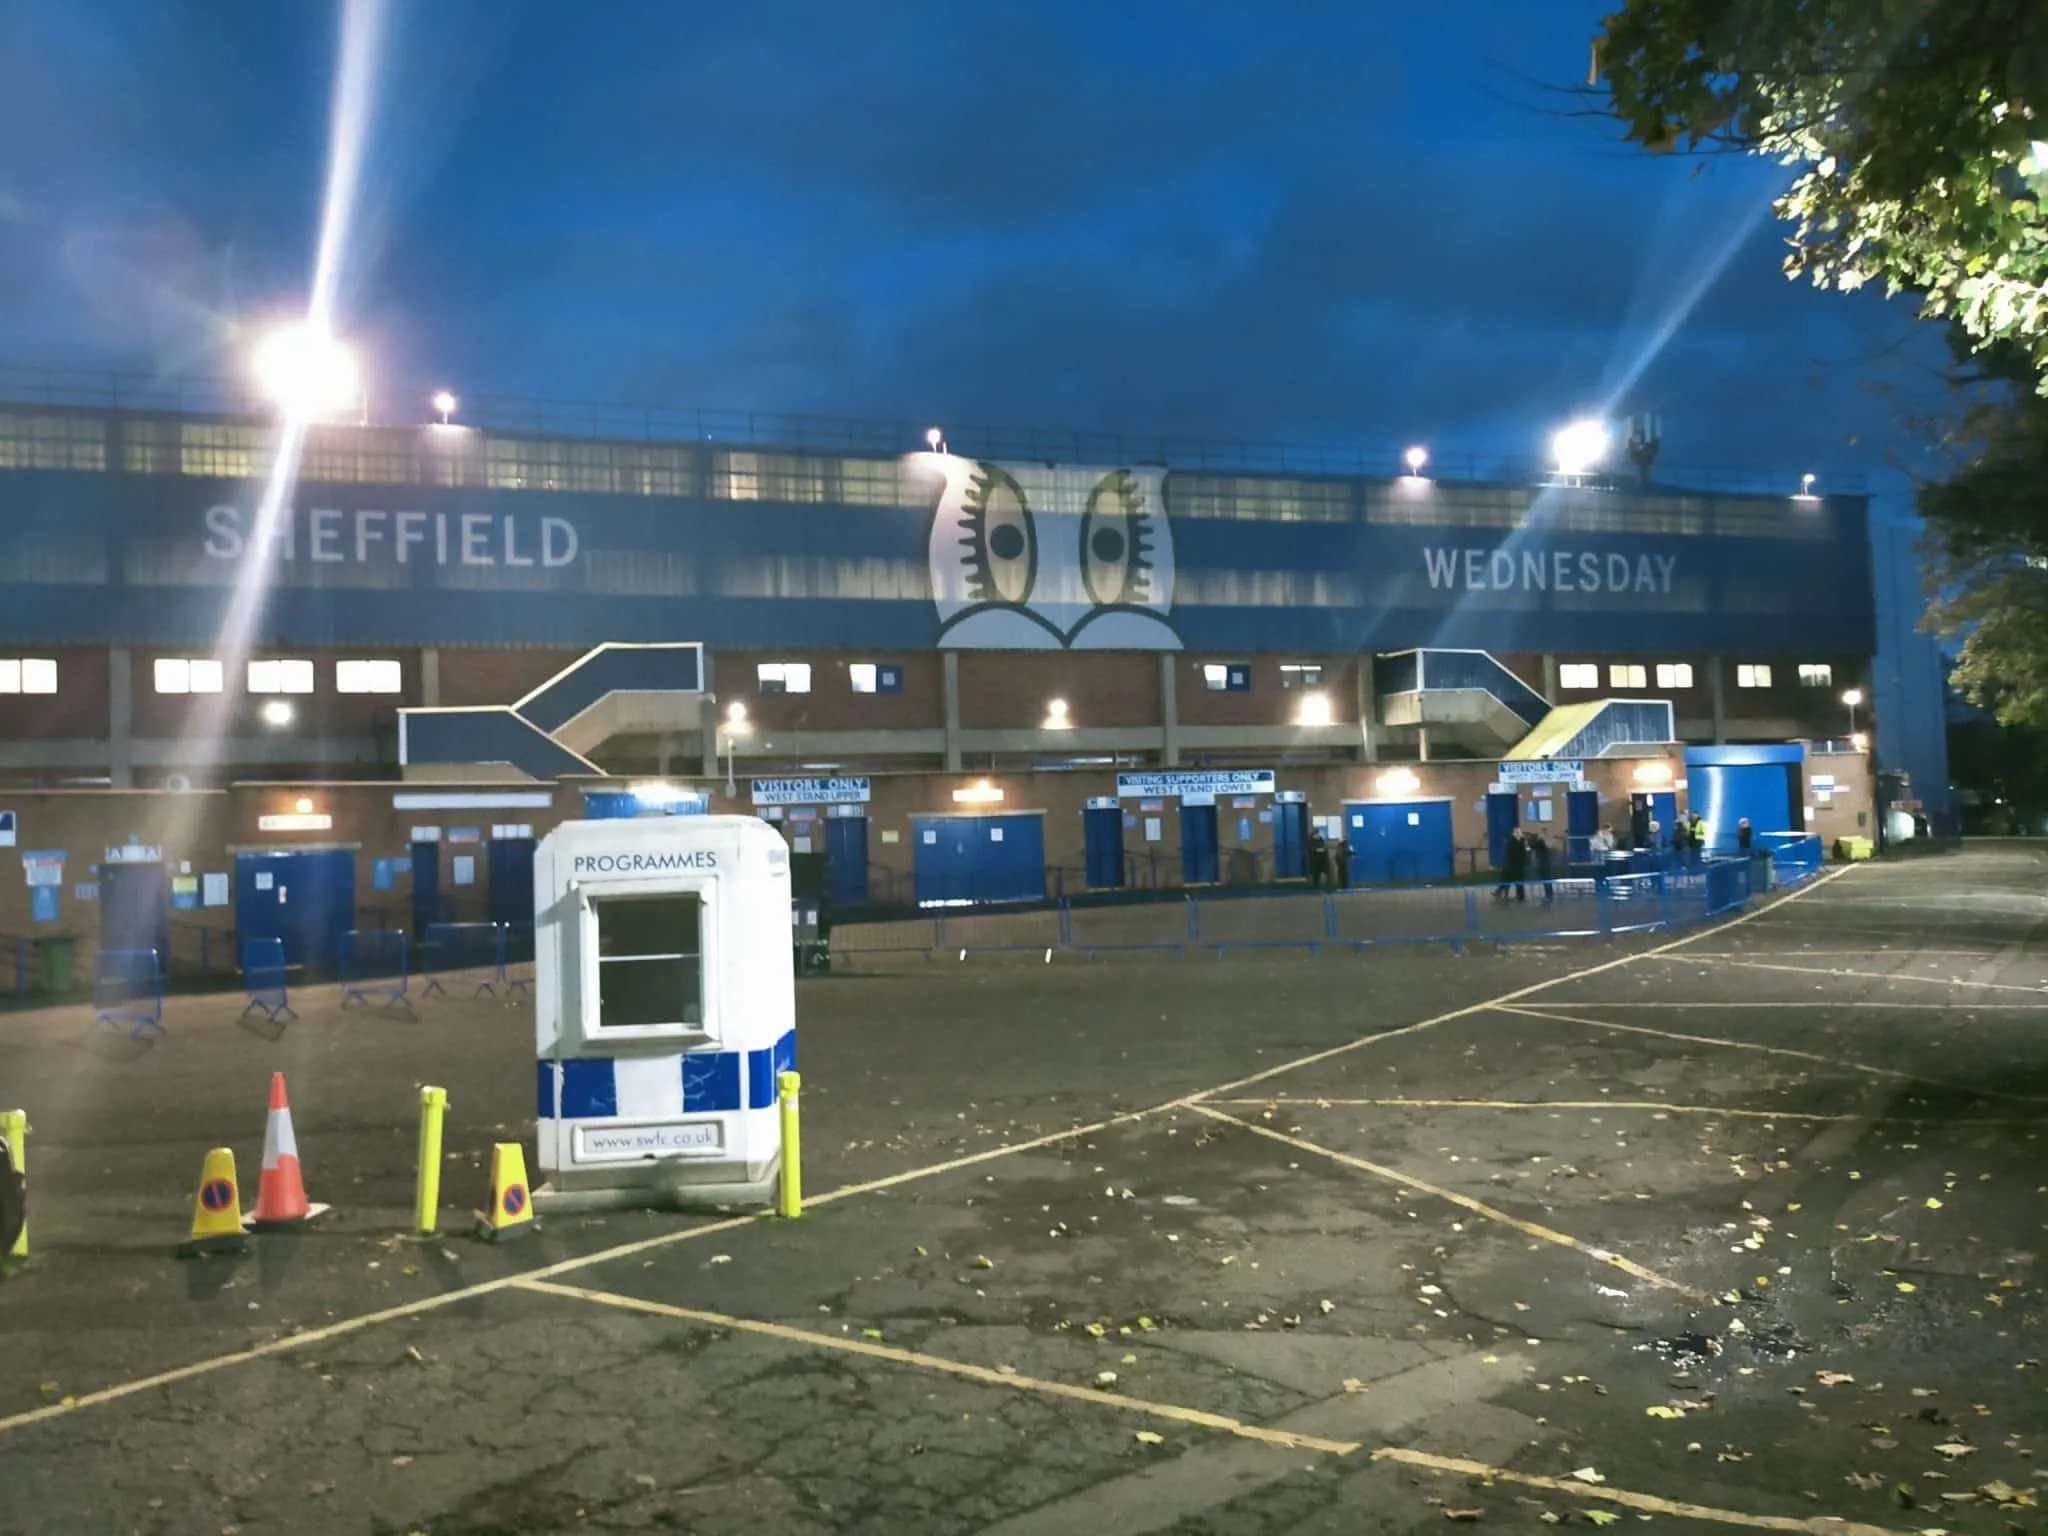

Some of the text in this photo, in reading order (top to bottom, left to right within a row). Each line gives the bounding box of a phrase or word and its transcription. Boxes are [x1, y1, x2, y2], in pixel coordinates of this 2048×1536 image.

[204, 504, 579, 568] SHEFFIELD
[1423, 546, 1677, 593] WEDNESDAY
[759, 778, 864, 792] VISITORS ONLY
[1125, 772, 1260, 786] VISITING SUPPORTERS ONLY
[765, 791, 792, 802] WEST
[796, 791, 828, 801] STAND
[1144, 783, 1253, 795] WEST STAND LOWER
[574, 851, 717, 872] PROGRAMMES
[593, 1128, 713, 1149] www.swfc.co.uk
